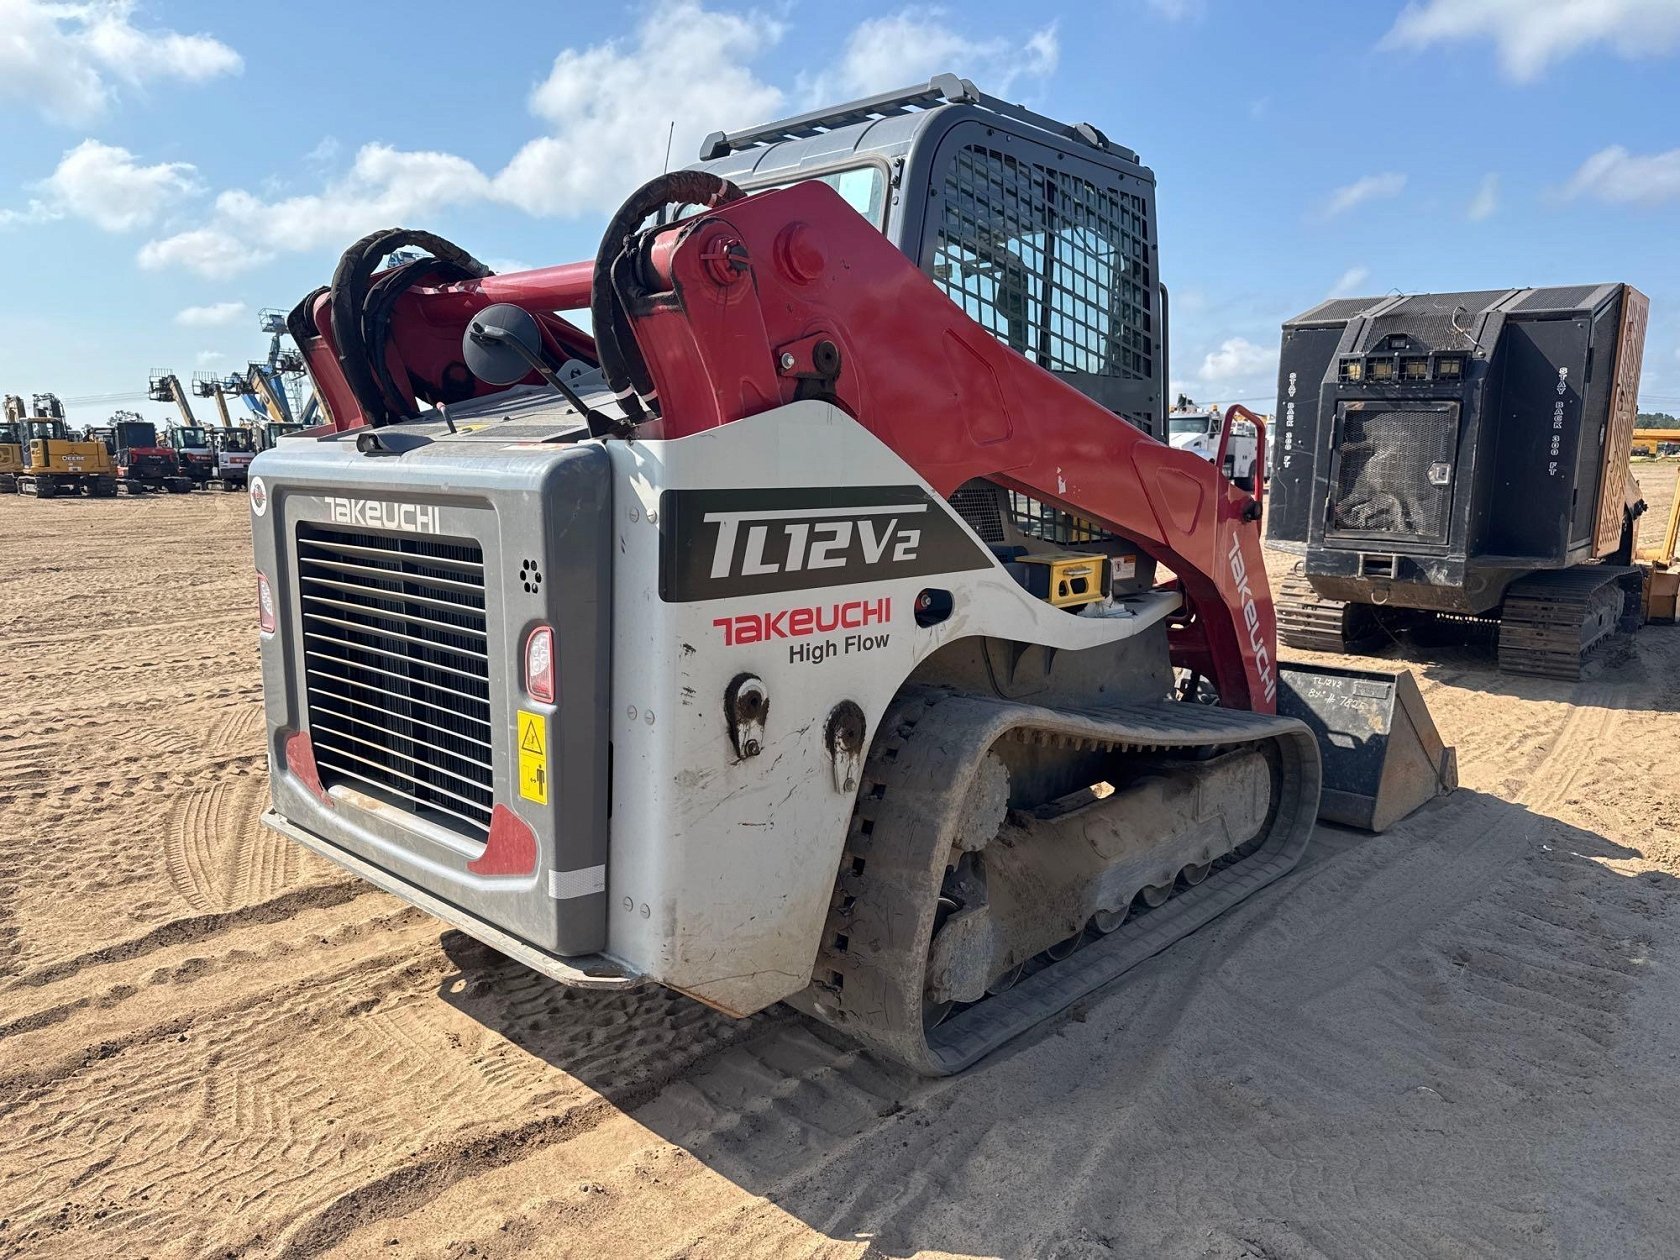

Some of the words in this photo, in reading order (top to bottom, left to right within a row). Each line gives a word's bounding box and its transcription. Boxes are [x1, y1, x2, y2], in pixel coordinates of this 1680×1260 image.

[1288, 372, 1297, 397] STAY
[1557, 367, 1568, 395] STAY
[1286, 402, 1295, 427] BACK
[1553, 401, 1563, 429] BACK
[1551, 435, 1560, 456] 300
[1548, 462, 1558, 476] FT
[703, 504, 928, 579] TL12V2
[789, 638, 837, 664] High
[846, 632, 890, 655] Flow
